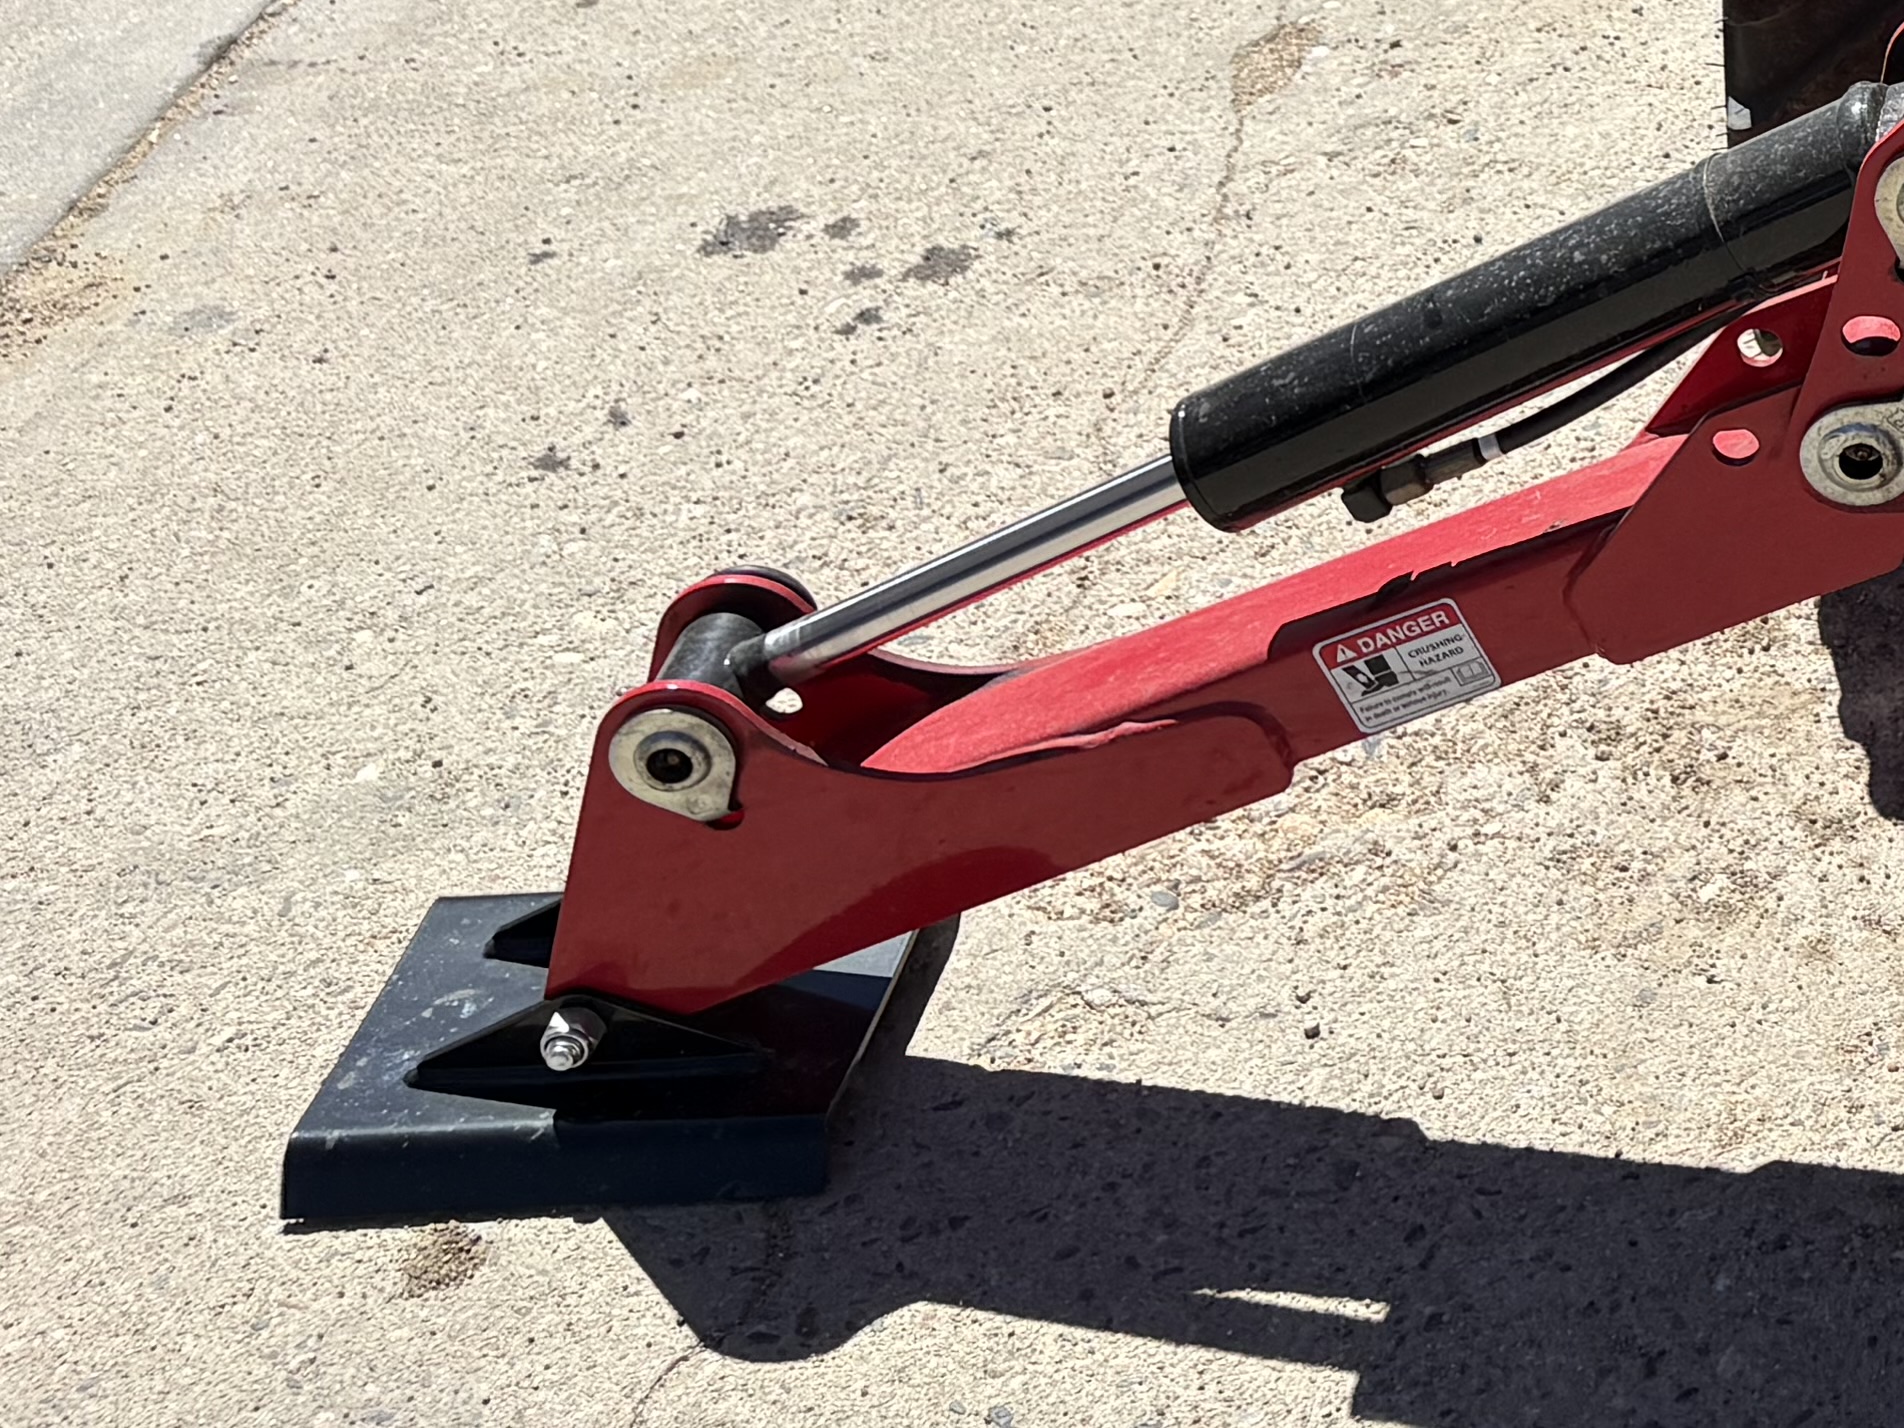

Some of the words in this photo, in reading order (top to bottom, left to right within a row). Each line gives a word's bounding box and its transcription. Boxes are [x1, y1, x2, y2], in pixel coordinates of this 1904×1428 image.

[1357, 609, 1450, 654] DANGER
[1408, 634, 1463, 659] CRUSHING
[1419, 645, 1465, 668] HAZARD
